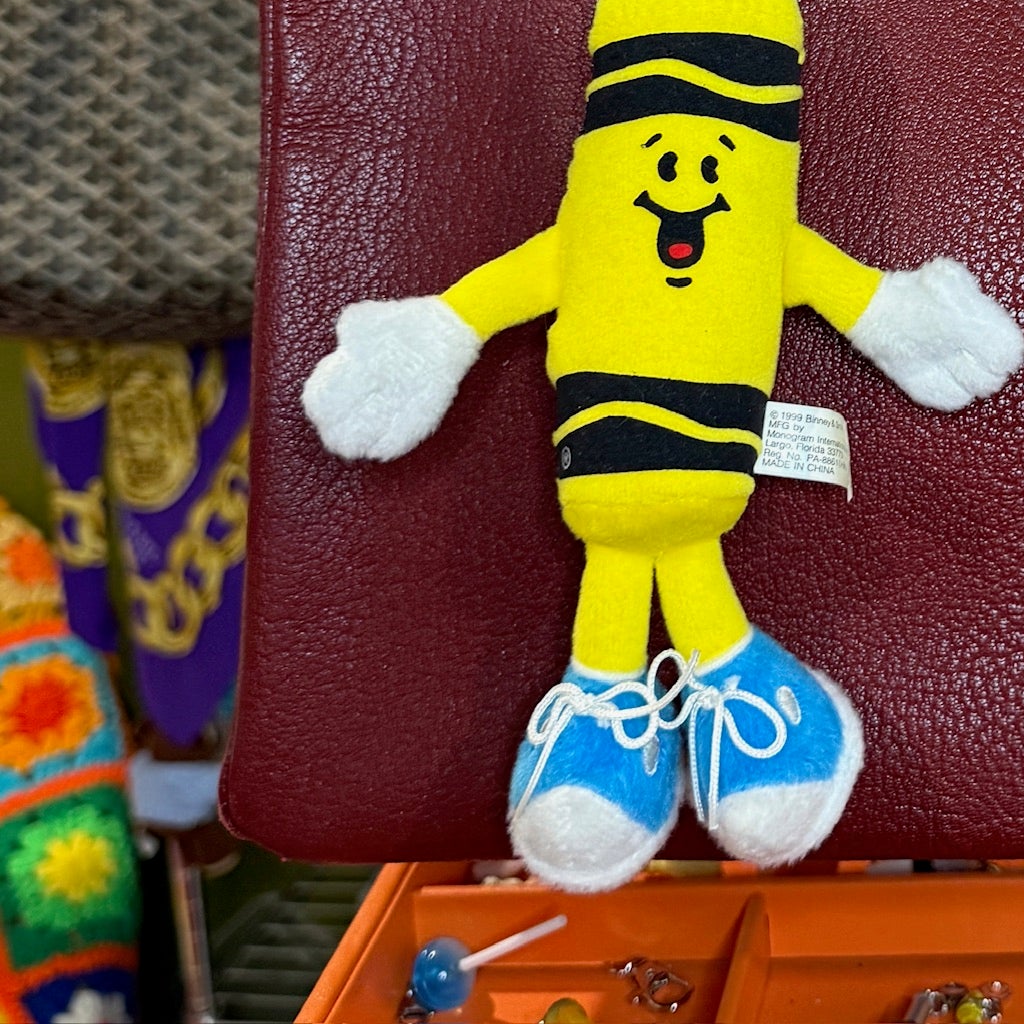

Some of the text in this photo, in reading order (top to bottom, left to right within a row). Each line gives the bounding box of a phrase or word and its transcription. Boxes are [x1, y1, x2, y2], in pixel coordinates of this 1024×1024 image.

[781, 411, 802, 422] 1999
[768, 420, 805, 433] MFG by
[767, 430, 815, 442] Monogram
[796, 442, 825, 454] Florida
[761, 458, 835, 475] MADE IN CHINA
